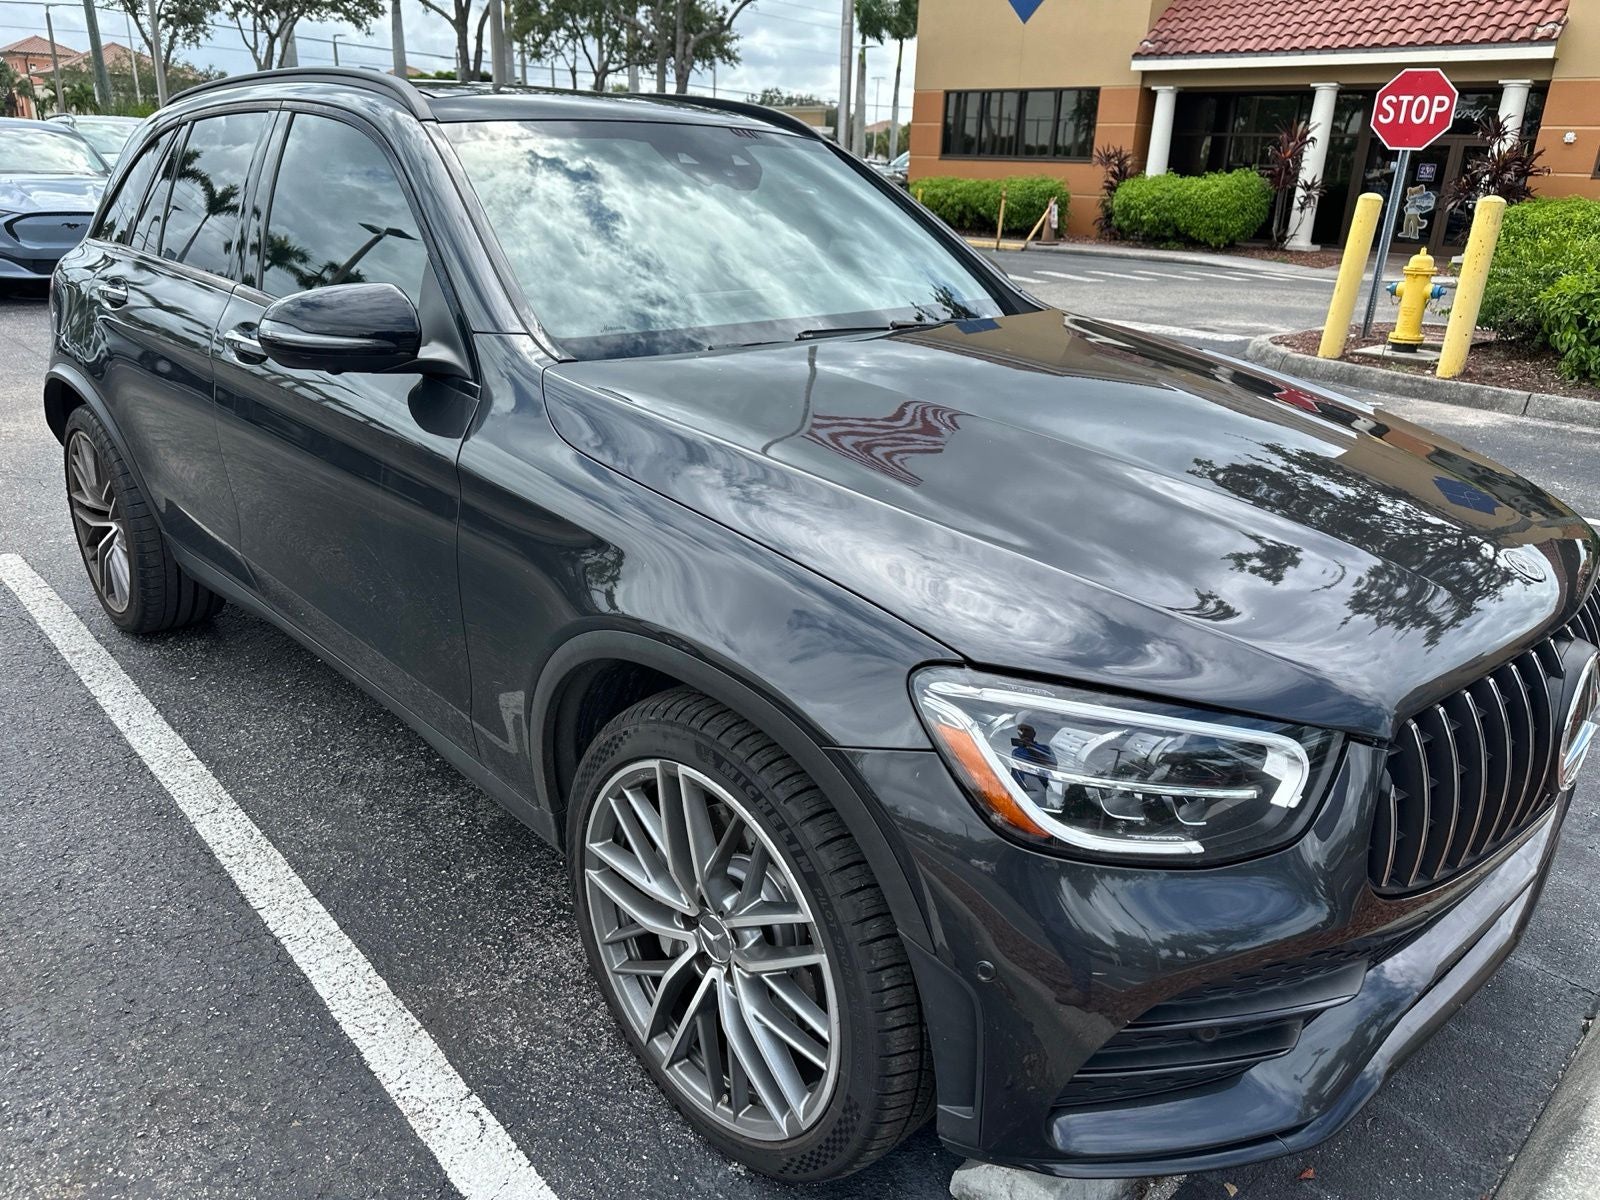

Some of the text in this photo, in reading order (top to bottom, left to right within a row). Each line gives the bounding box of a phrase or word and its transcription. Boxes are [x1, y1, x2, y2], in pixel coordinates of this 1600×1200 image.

[1378, 95, 1450, 124] STOP
[1455, 101, 1488, 122] ord
[720, 761, 816, 873] MICHELIN
[815, 887, 838, 930] PILOT
